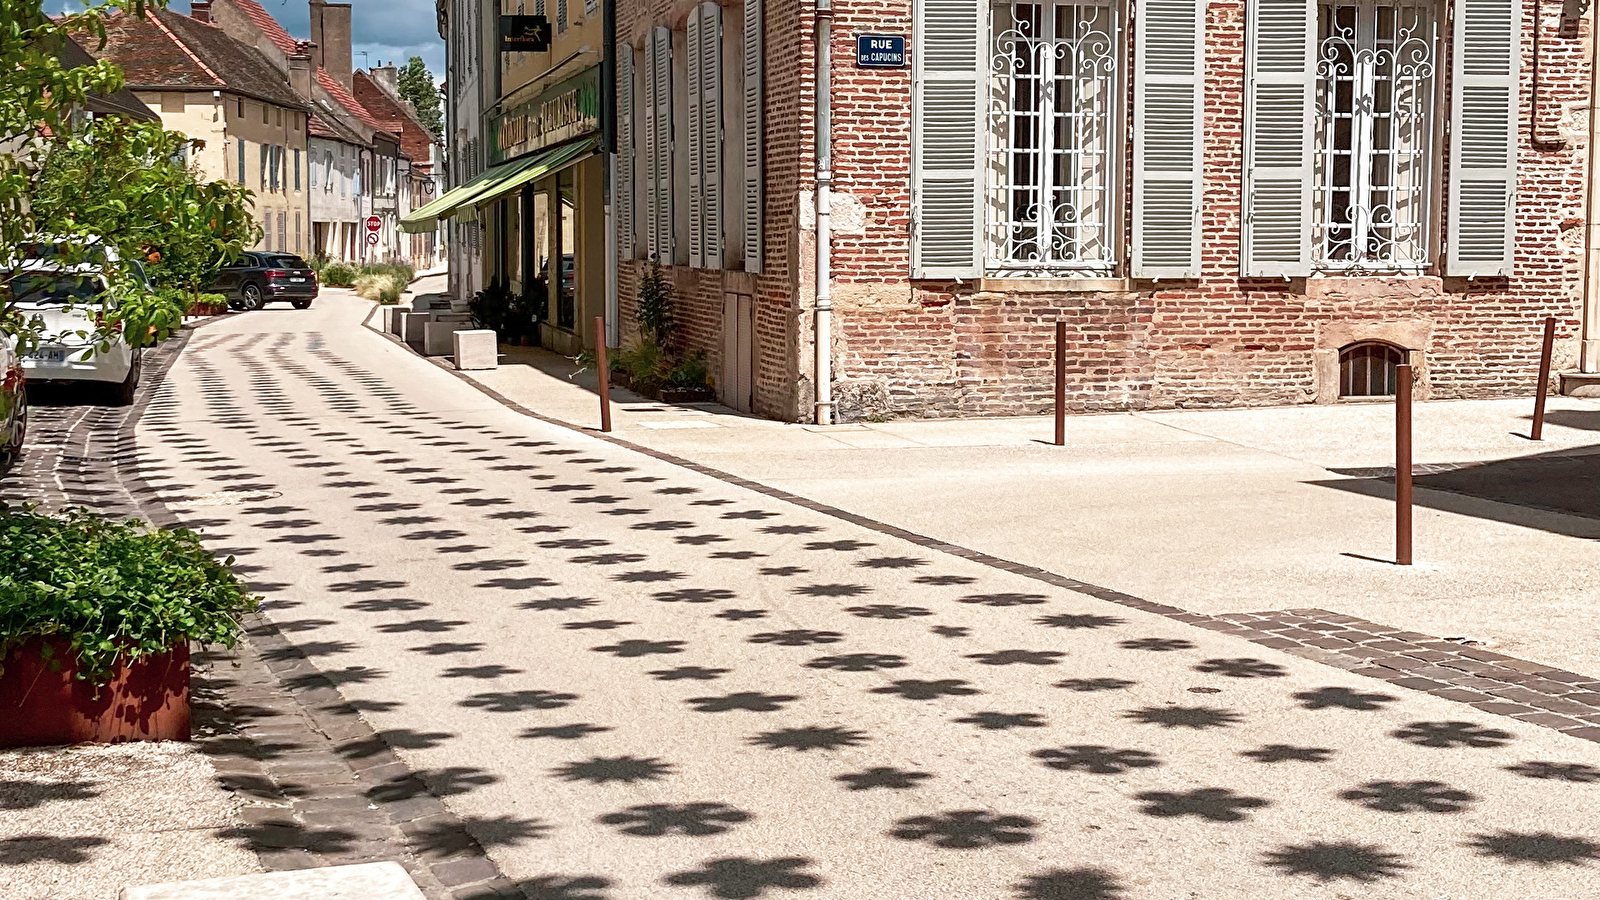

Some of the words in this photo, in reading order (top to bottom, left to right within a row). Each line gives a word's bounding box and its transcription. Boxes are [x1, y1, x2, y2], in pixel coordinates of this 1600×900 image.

[870, 39, 893, 49] RUE
[860, 54, 870, 62] DES
[870, 52, 902, 62] CAPUCINS
